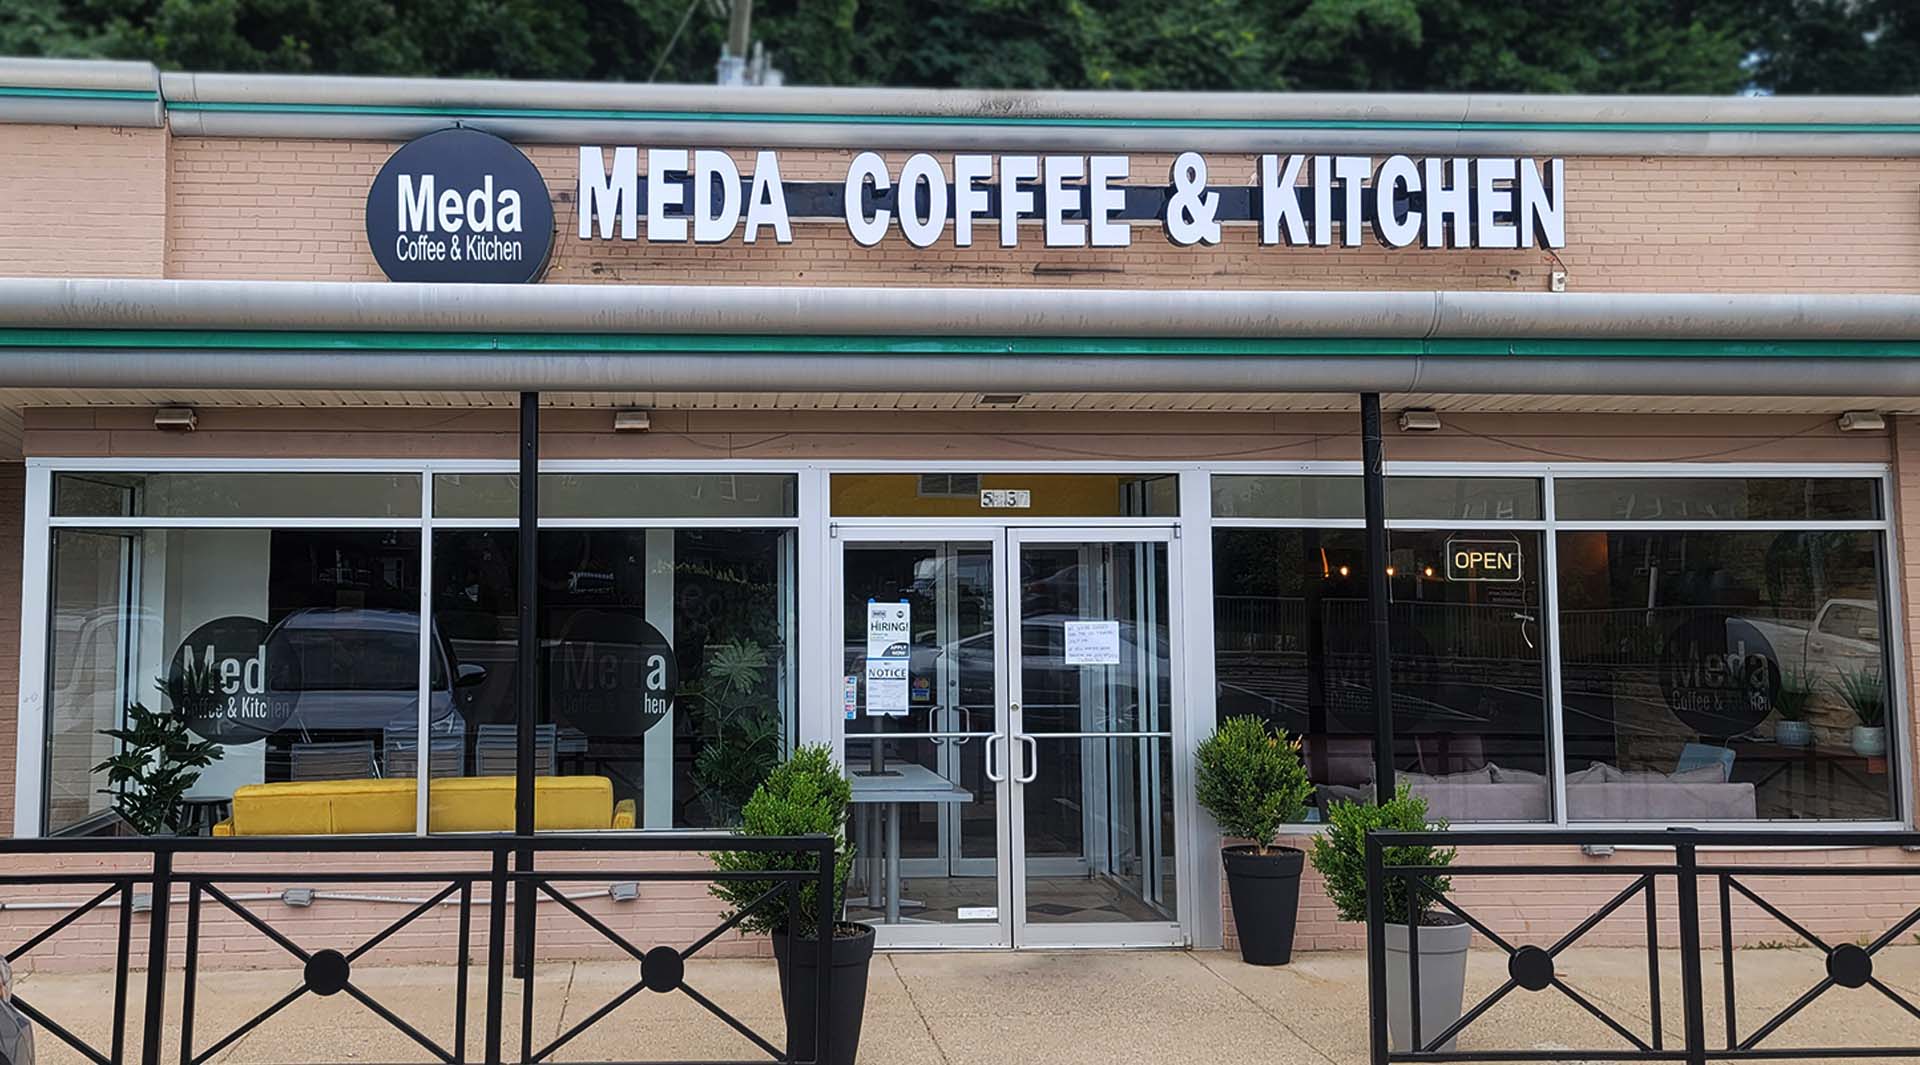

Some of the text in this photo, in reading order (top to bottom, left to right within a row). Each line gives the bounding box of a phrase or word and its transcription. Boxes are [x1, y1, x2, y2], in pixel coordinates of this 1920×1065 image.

[397, 174, 522, 233] Meda
[578, 145, 1566, 249] MEDA COFFEE & KITCHEN
[396, 234, 522, 262] Coffee & Kitchen
[1455, 551, 1512, 570] OPEN
[870, 621, 909, 632] HIRING!
[183, 644, 267, 695] Med
[868, 668, 907, 677] NOTICE
[227, 696, 238, 719] &
